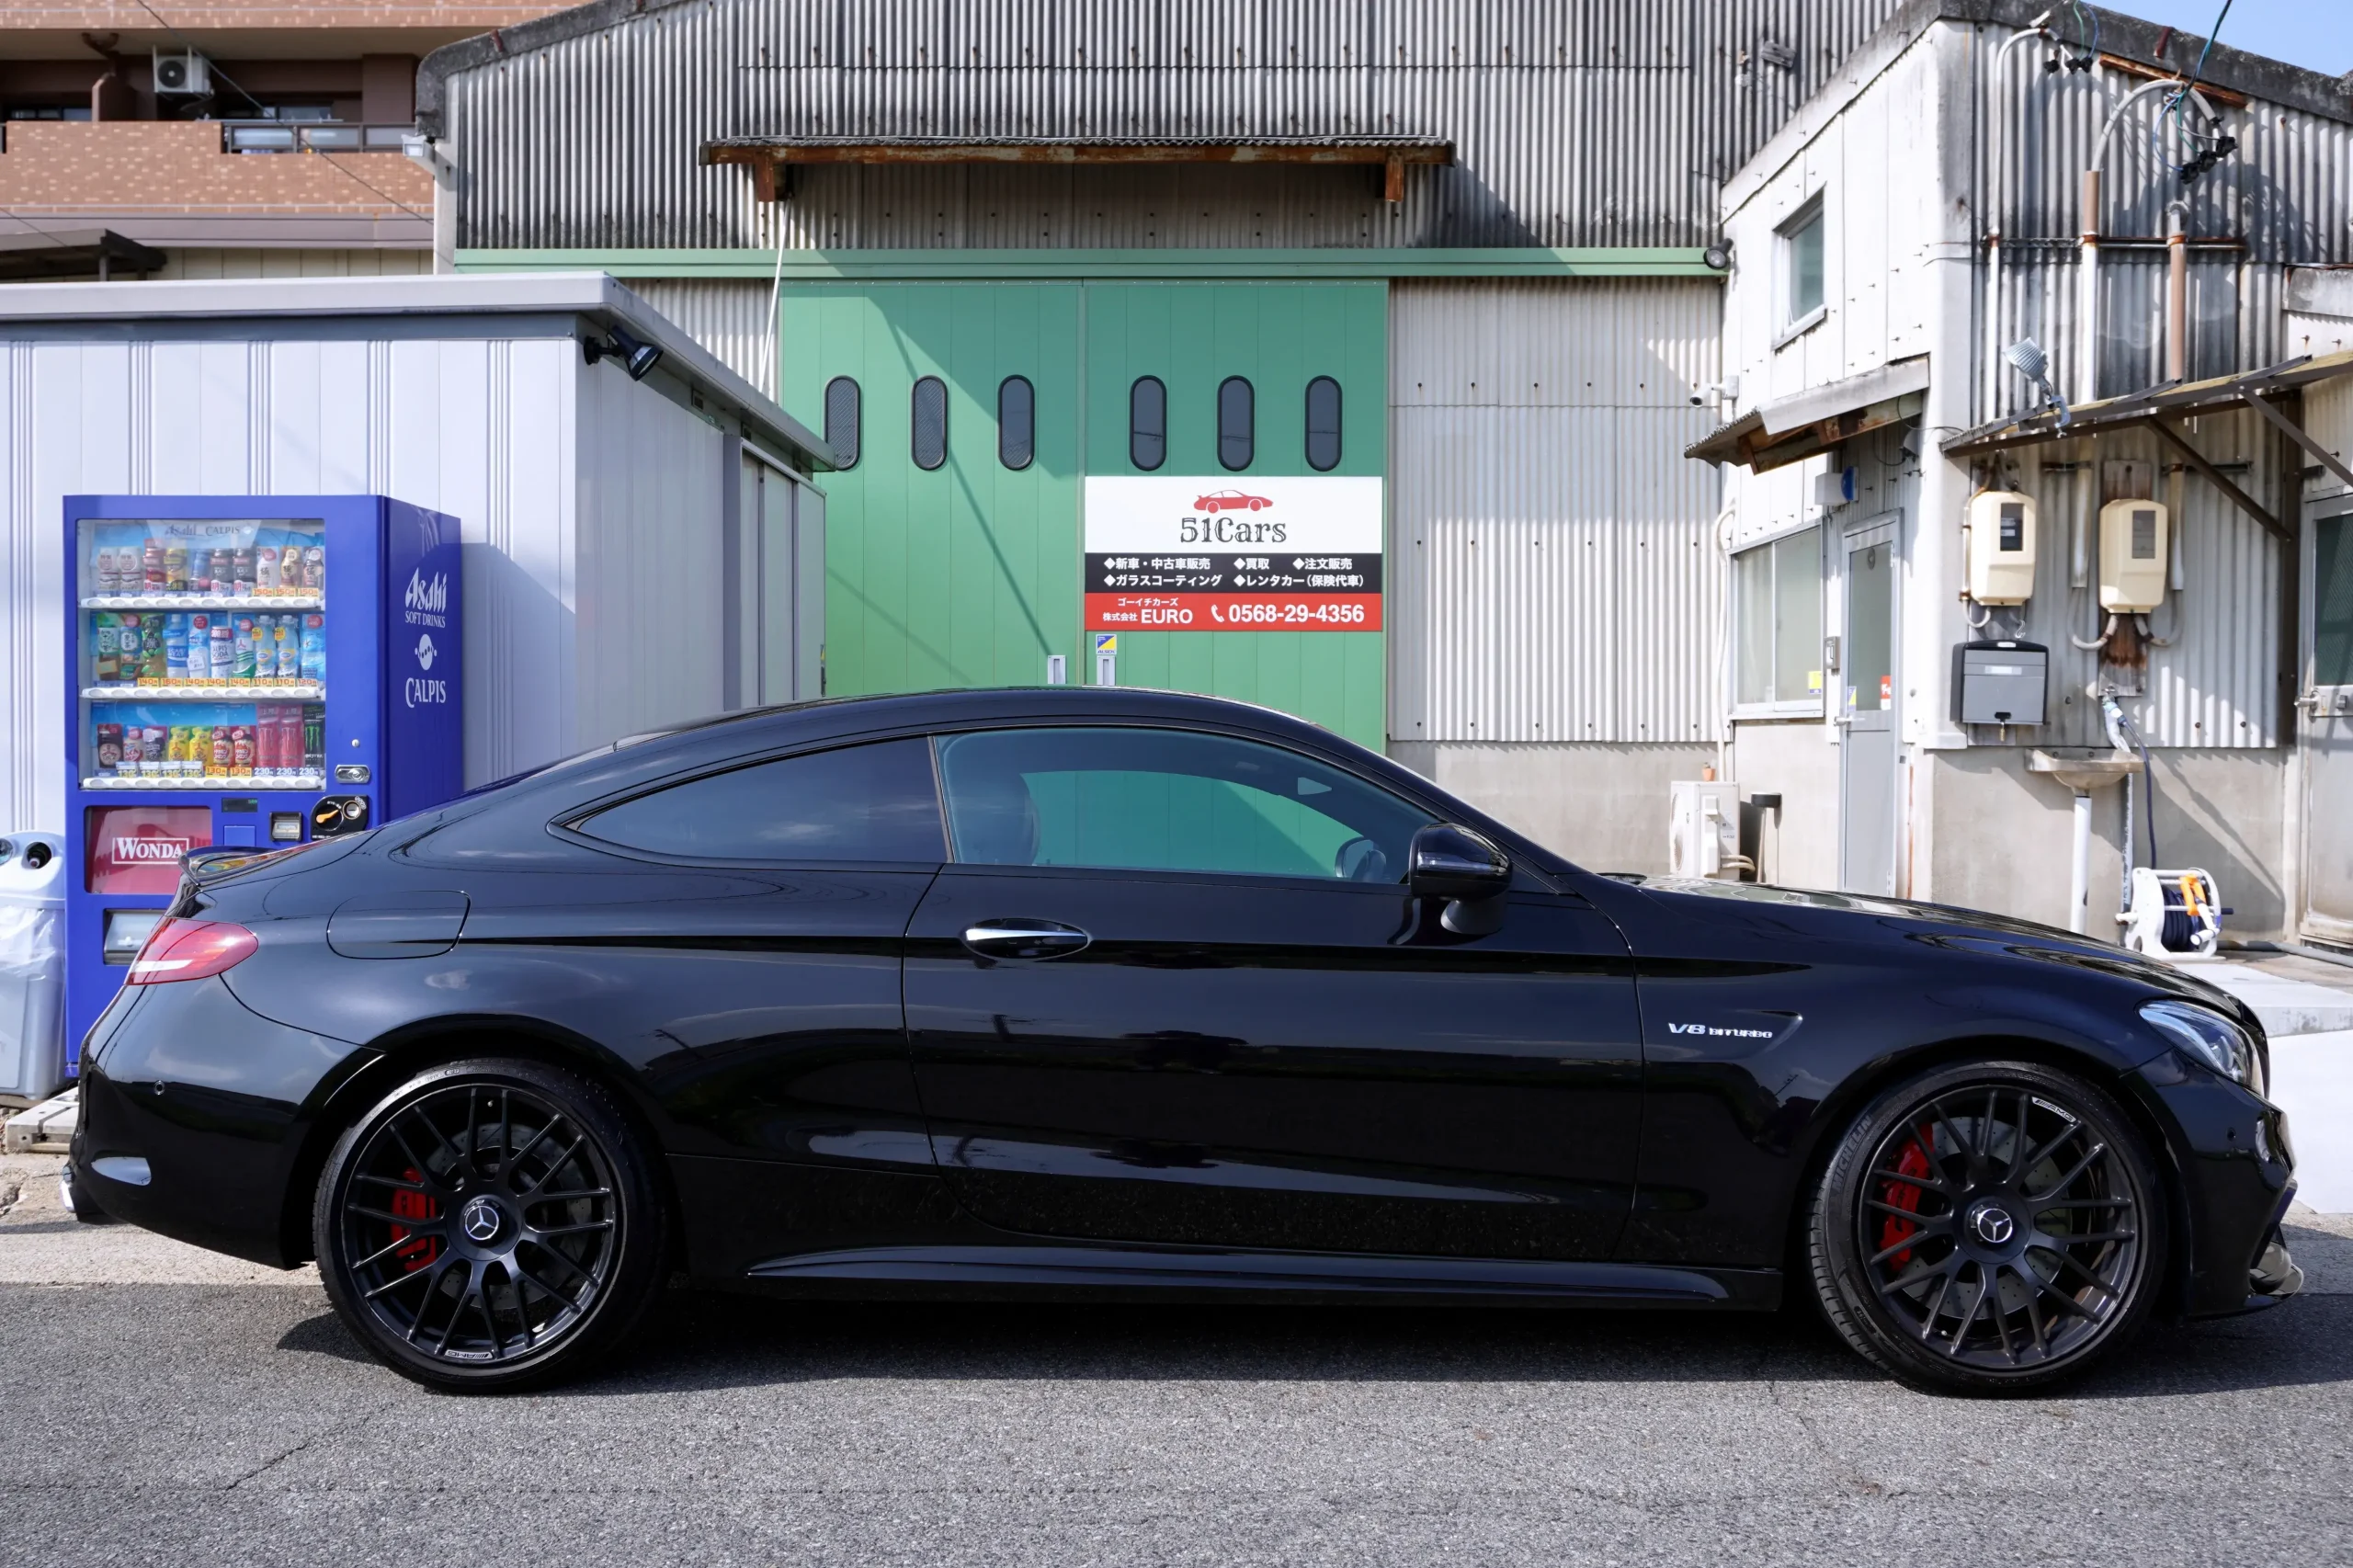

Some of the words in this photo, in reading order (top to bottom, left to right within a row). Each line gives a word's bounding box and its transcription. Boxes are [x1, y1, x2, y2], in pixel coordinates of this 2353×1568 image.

[206, 526, 239, 536] CALPIS
[1180, 517, 1287, 543] 51Cars
[1116, 558, 1211, 570] 新車・中古車販売
[1245, 558, 1269, 570] 買取
[1304, 558, 1352, 570] 注文販売
[405, 567, 447, 612] Asahi
[1116, 574, 1222, 587] ガラスコーティング
[1118, 597, 1178, 607] ゴーイチカーズ
[405, 610, 422, 625] SOFT
[423, 614, 446, 628] DRINKS
[1103, 612, 1138, 621] 株式会社
[1141, 608, 1193, 624] EURO
[1228, 604, 1365, 623] 0568-29-4356
[405, 677, 447, 708] CALPIS
[116, 837, 183, 859] WONDA
[1668, 1022, 1706, 1035] V8
[1709, 1028, 1773, 1039] BITURBO
[1831, 1113, 1873, 1194] MICHELIN
